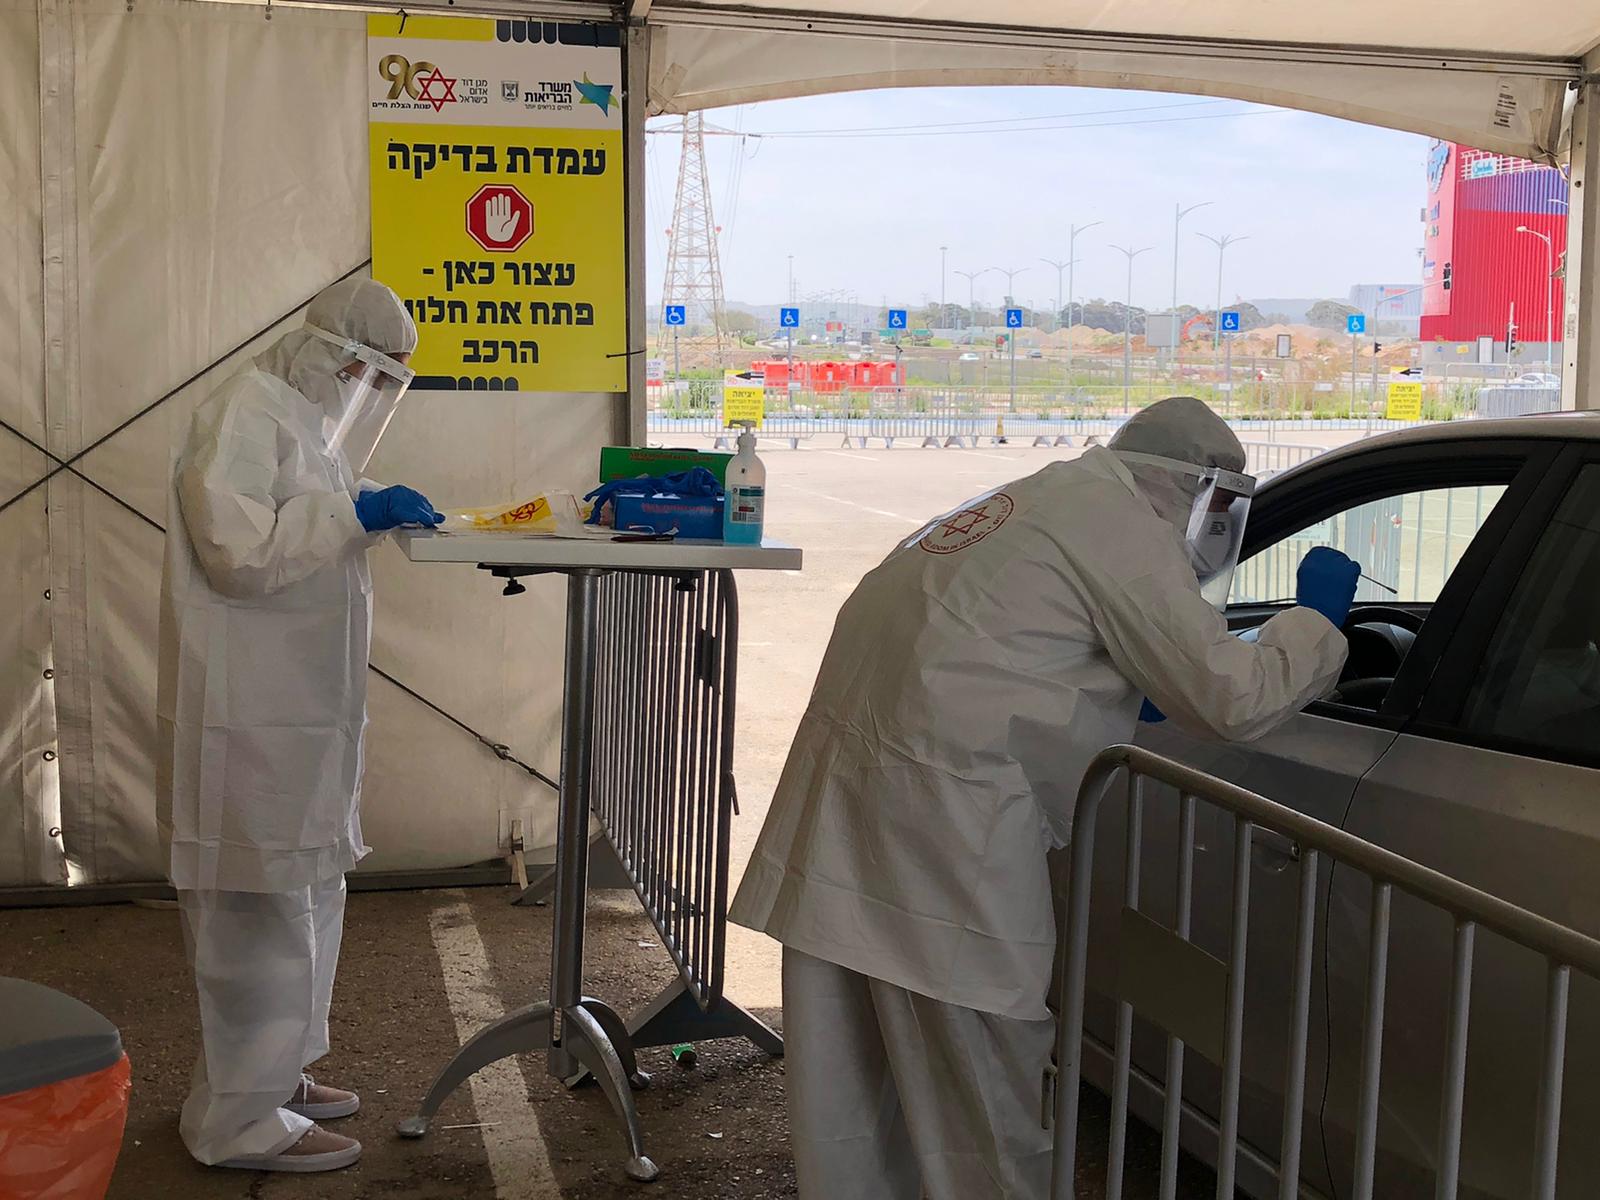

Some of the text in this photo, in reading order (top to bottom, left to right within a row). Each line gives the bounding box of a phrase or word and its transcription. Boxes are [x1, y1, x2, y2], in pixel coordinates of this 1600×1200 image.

[469, 87, 488, 95] אדום
[475, 79, 488, 87] מגן
[539, 82, 572, 93] משרד
[459, 95, 488, 104] בישראל
[524, 92, 572, 103] הבריאות
[387, 143, 606, 179] עמדת בדיקה
[443, 260, 495, 291] כאן
[503, 261, 576, 286] עצור
[476, 300, 521, 325] את
[529, 301, 594, 326] פתח
[462, 339, 539, 364] הרכב
